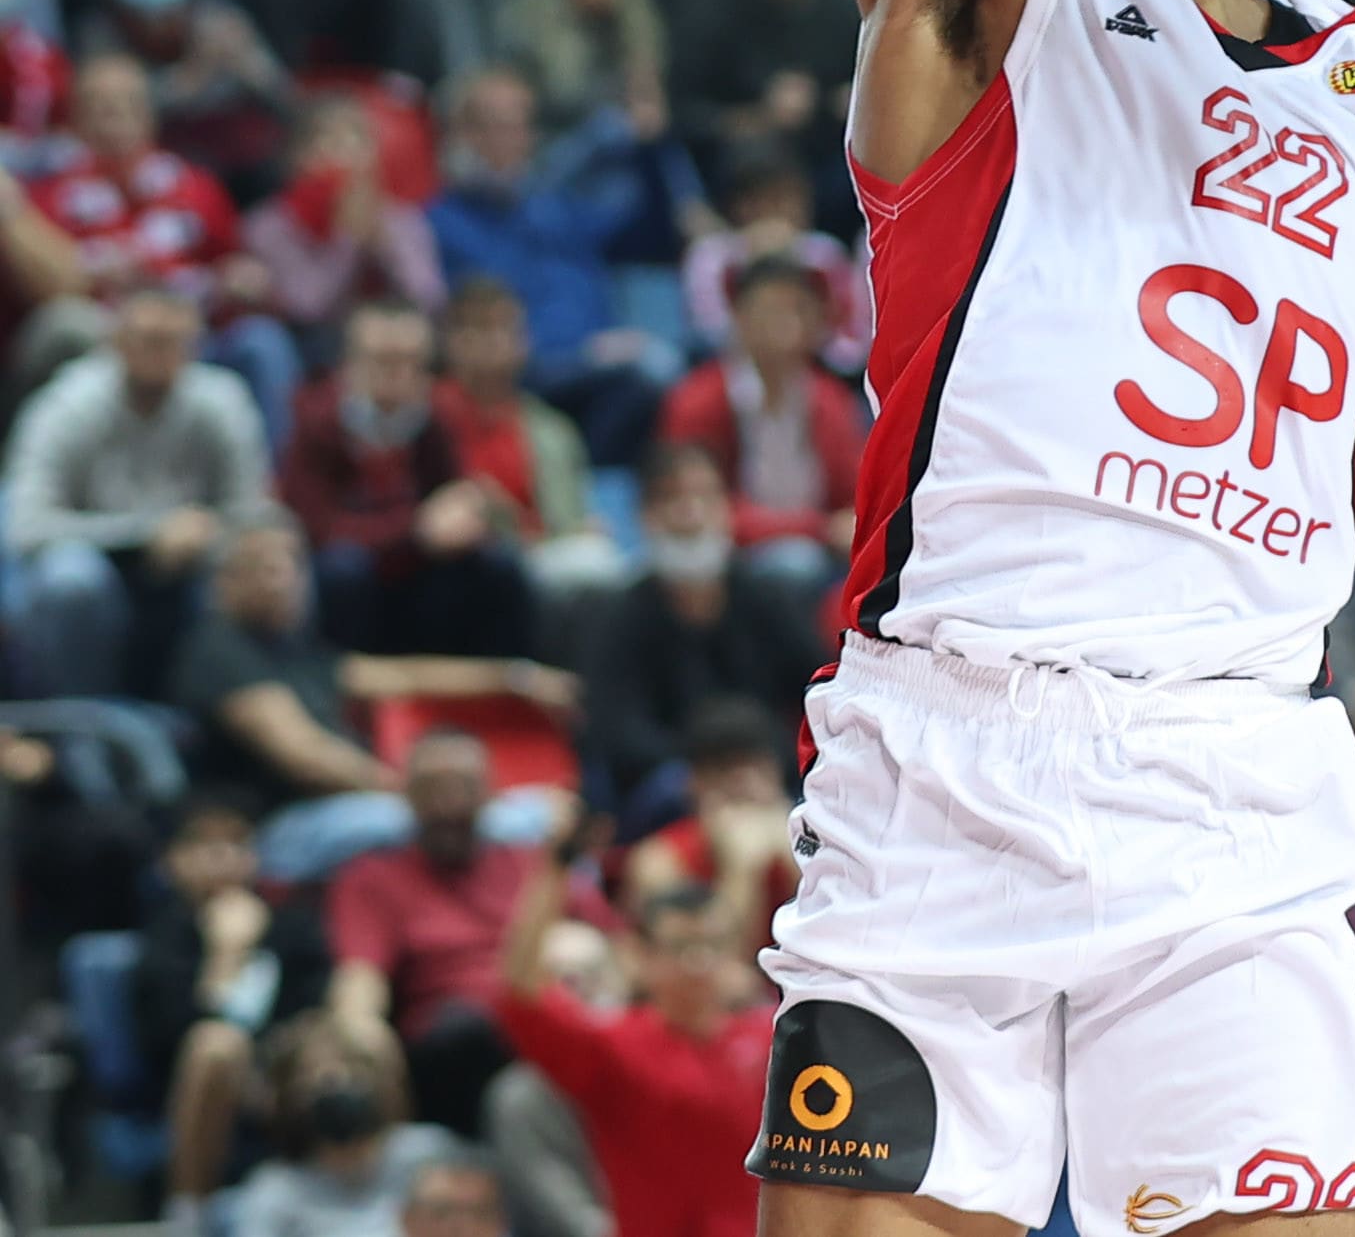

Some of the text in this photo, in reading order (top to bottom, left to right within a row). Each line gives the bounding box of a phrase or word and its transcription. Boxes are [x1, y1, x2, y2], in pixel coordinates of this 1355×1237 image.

[1192, 87, 1349, 260] 22
[1114, 264, 1349, 470] SP
[1094, 450, 1331, 565] metzer
[803, 1162, 813, 1173] &
[819, 1163, 864, 1177] Sushi
[818, 1138, 890, 1160] JAPAN
